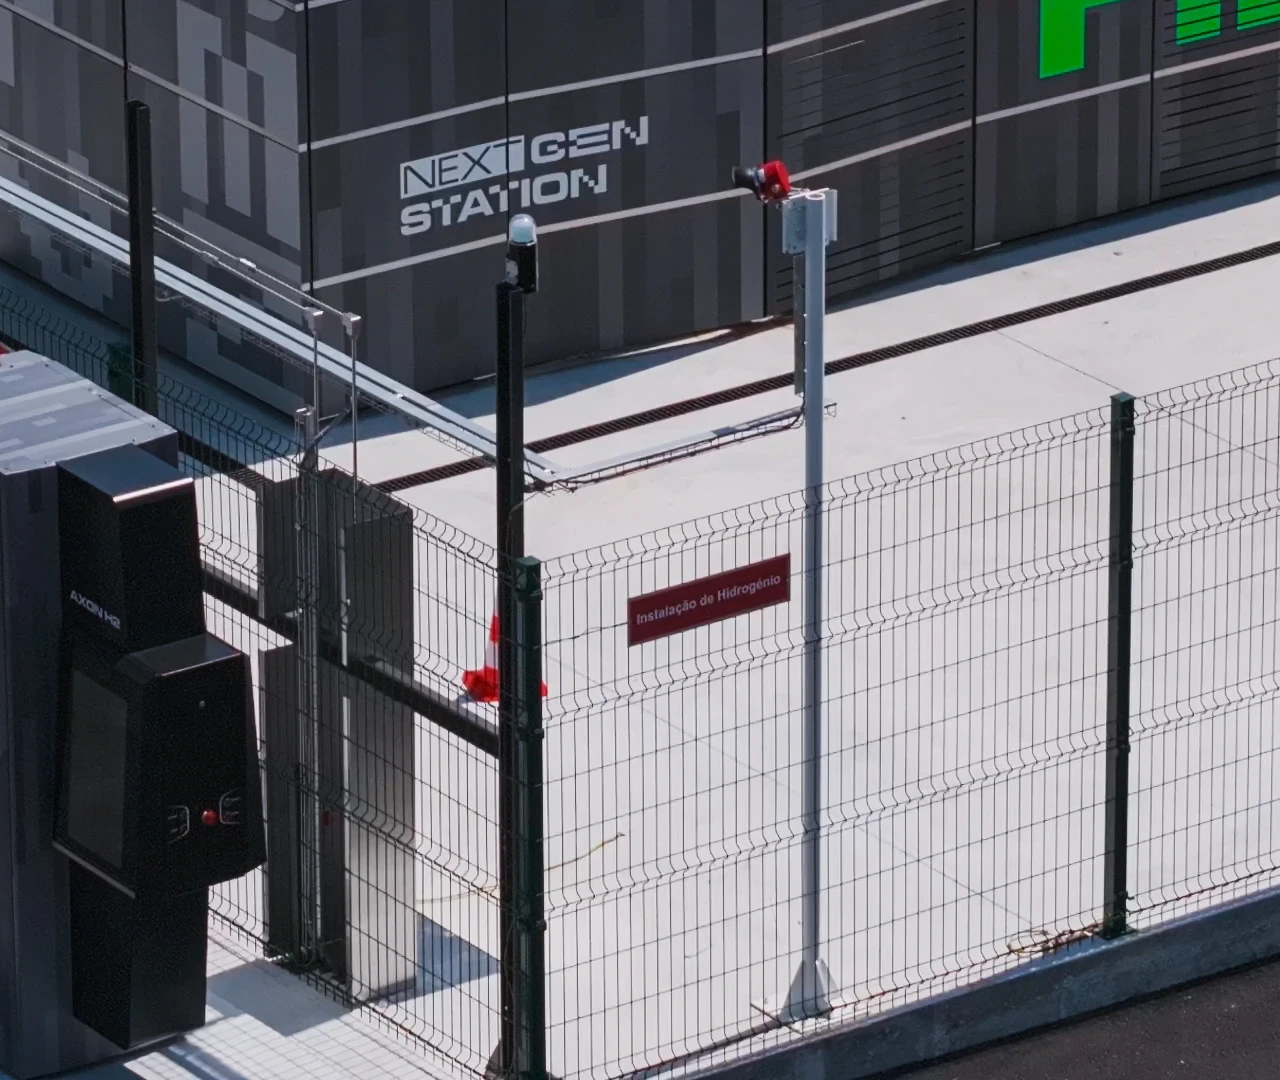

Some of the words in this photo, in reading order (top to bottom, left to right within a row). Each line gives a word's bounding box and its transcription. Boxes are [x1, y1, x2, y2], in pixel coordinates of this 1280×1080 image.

[401, 137, 524, 197] NEXT
[530, 115, 649, 165] GEN
[400, 164, 608, 236] STATION
[70, 590, 103, 619] AXON
[636, 600, 697, 625] Instalação
[699, 593, 714, 607] de
